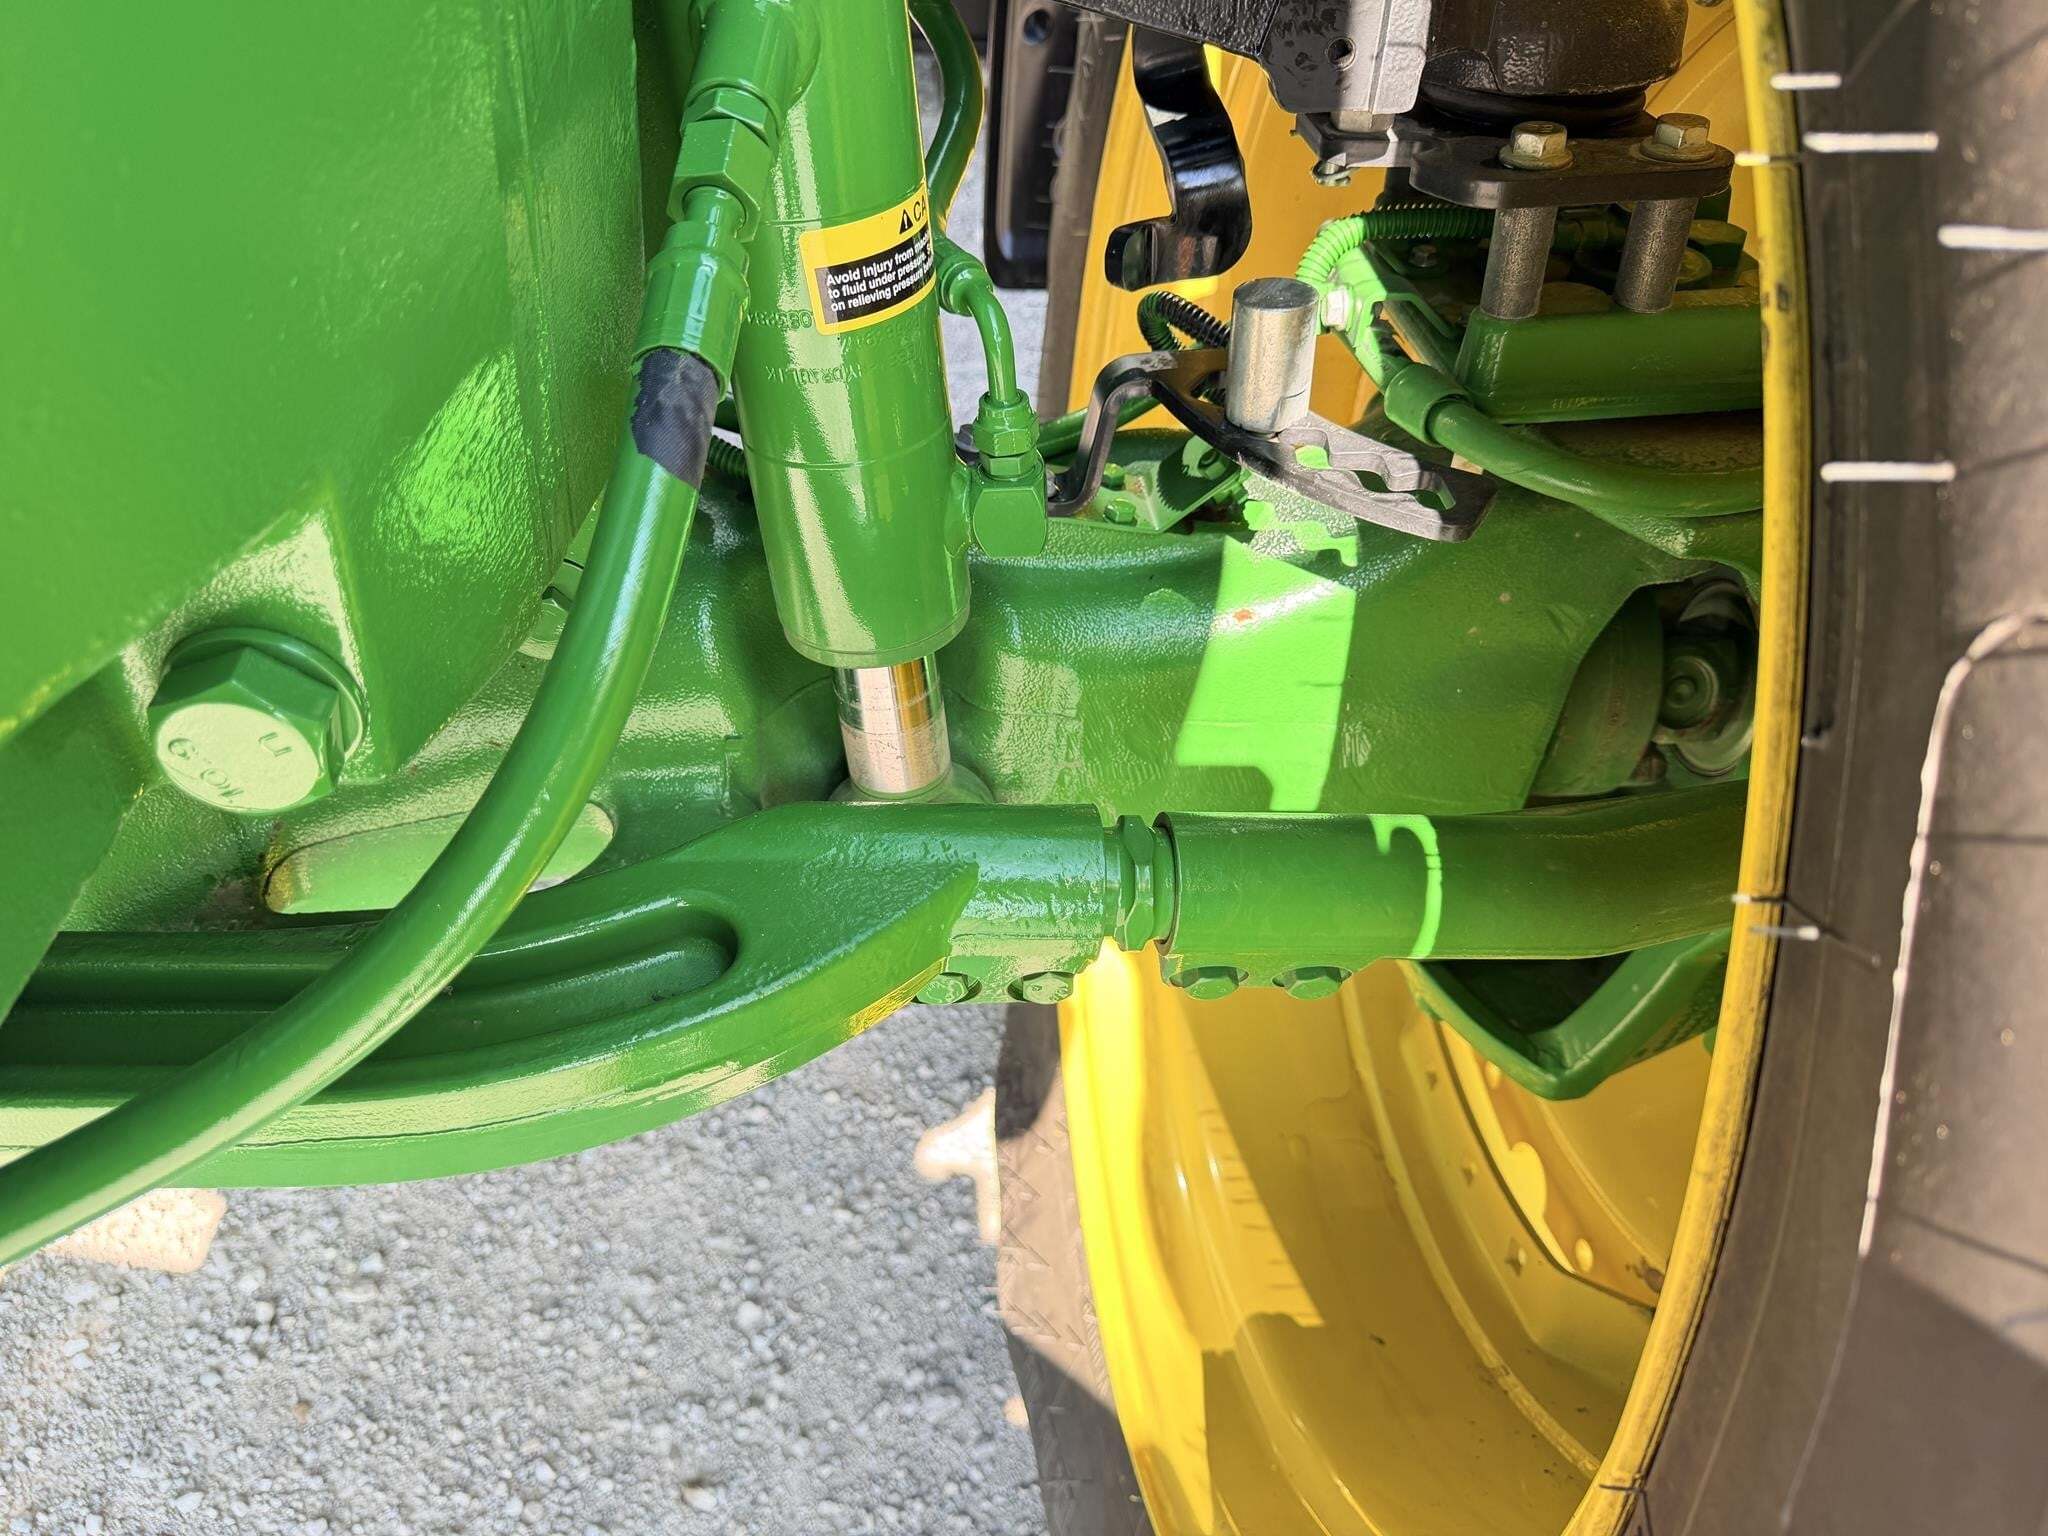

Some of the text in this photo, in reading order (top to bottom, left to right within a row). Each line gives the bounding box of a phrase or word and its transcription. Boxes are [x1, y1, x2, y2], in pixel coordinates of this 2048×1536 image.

[913, 194, 927, 222] CA
[827, 267, 861, 287] Avoid
[894, 247, 914, 264] from
[827, 287, 841, 300] to
[842, 280, 867, 297] fluid
[868, 270, 896, 290] under
[831, 300, 846, 312] on
[847, 288, 892, 309] relieving
